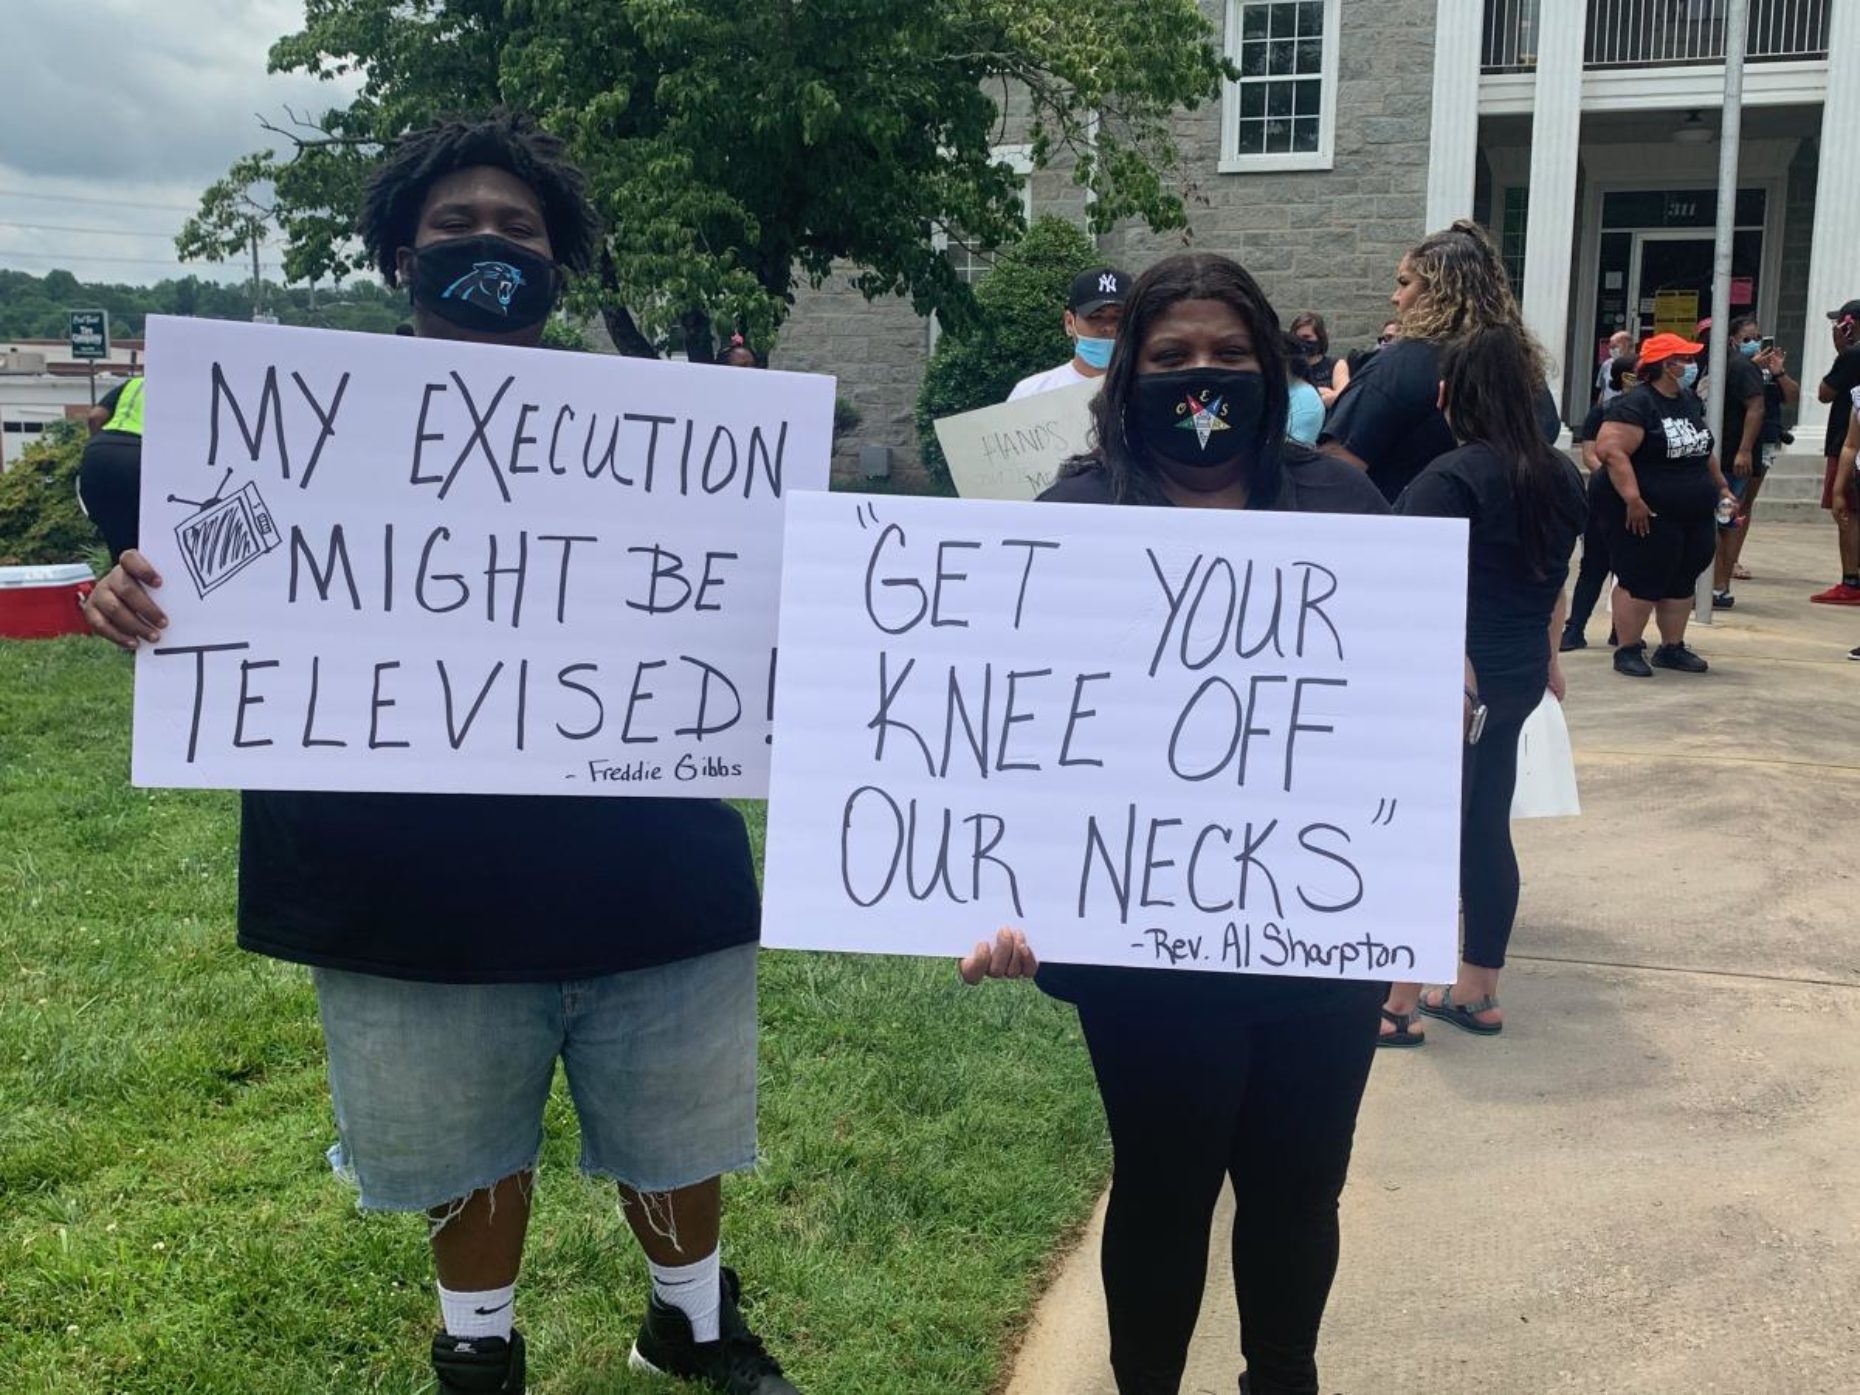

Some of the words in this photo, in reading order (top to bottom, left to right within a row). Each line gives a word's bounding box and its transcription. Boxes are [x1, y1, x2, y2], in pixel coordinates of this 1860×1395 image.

[1667, 202, 1696, 217] 311
[1098, 273, 1117, 292] NY
[208, 361, 350, 489] MY
[409, 370, 788, 502] EXECUTION
[289, 523, 598, 627] MIGHT
[625, 543, 739, 615] BE
[855, 502, 1061, 635] "GET
[1145, 548, 1344, 678] YOUR
[153, 641, 778, 763] TELEVISED!
[867, 651, 1111, 779] KNEE
[1168, 675, 1348, 792] OFF
[588, 759, 662, 782] Freddie
[674, 753, 742, 781] Gibbs
[841, 785, 1024, 918] OUR
[1078, 798, 1397, 924] NECKS"
[1221, 922, 1250, 968] Al
[1260, 922, 1415, 974] Sharpton
